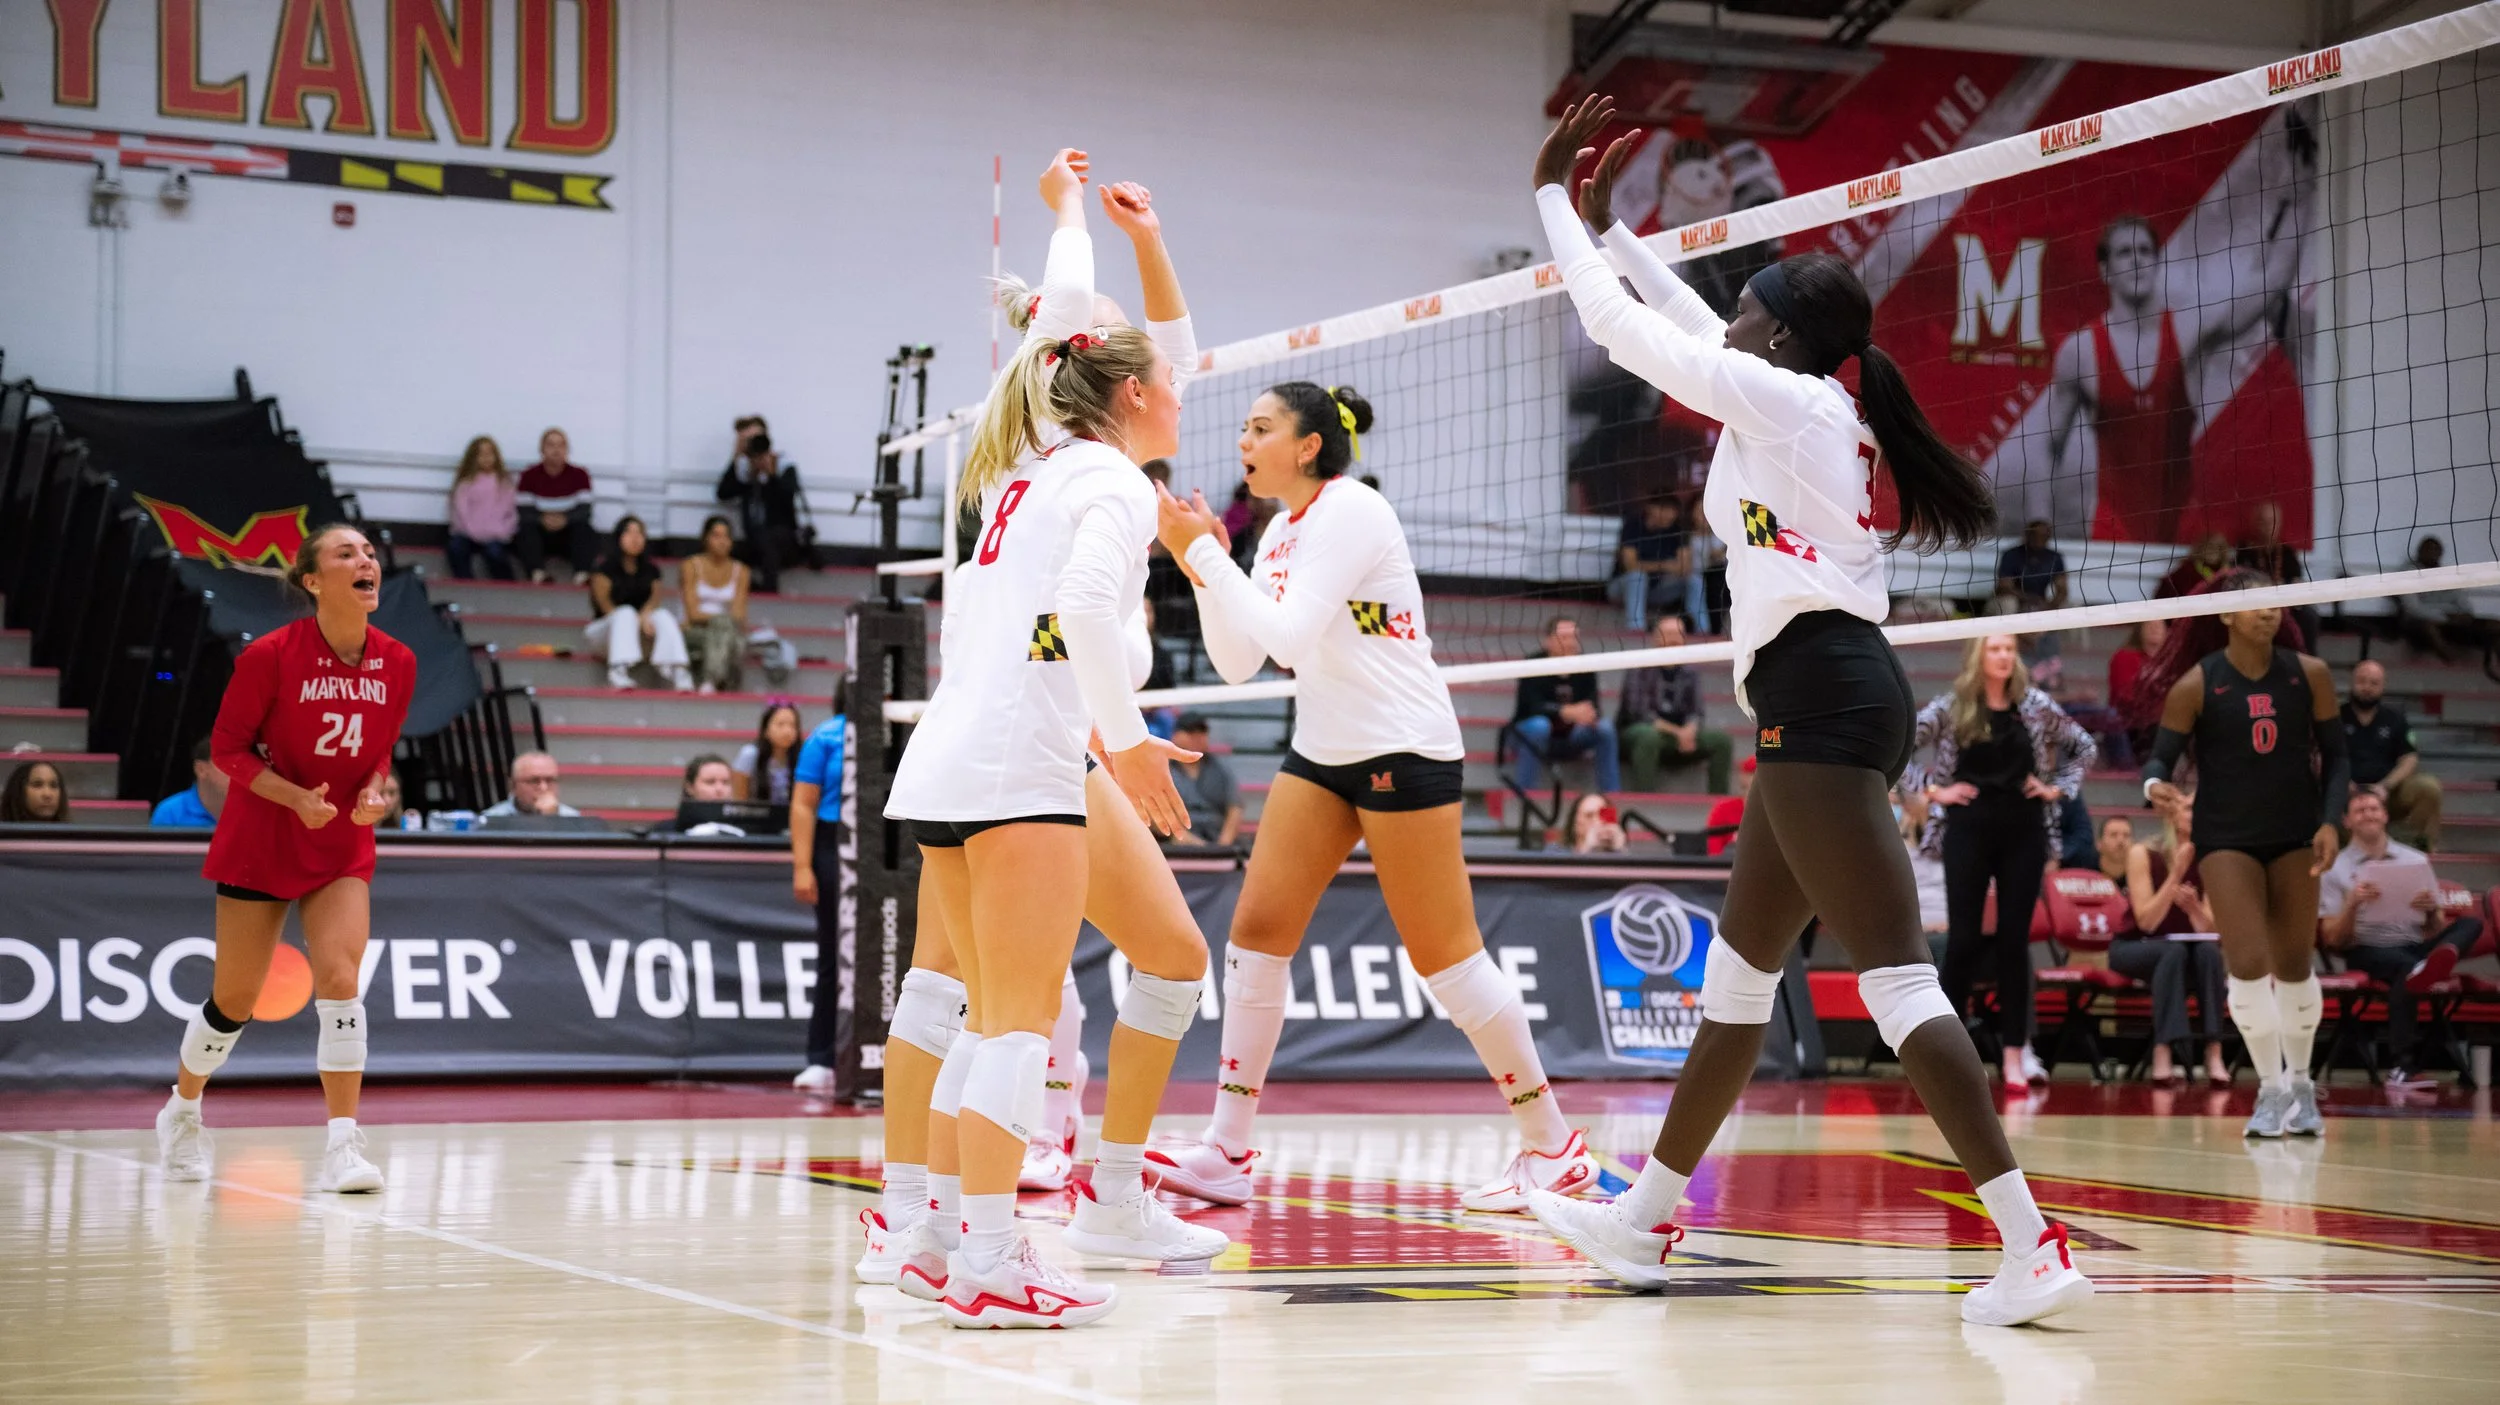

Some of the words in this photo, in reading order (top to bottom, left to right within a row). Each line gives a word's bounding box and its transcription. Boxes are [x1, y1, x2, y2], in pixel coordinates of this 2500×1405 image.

[2267, 47, 2342, 90] MARYLAND
[2040, 113, 2103, 152] MARYLAND
[1847, 170, 1902, 203] MARYLAND
[1680, 218, 1728, 246] MARYLAND
[1951, 232, 2047, 350] M
[299, 676, 387, 705] MARYLAND
[2246, 693, 2277, 718] R
[314, 711, 364, 757] 24
[2252, 718, 2278, 754] 0
